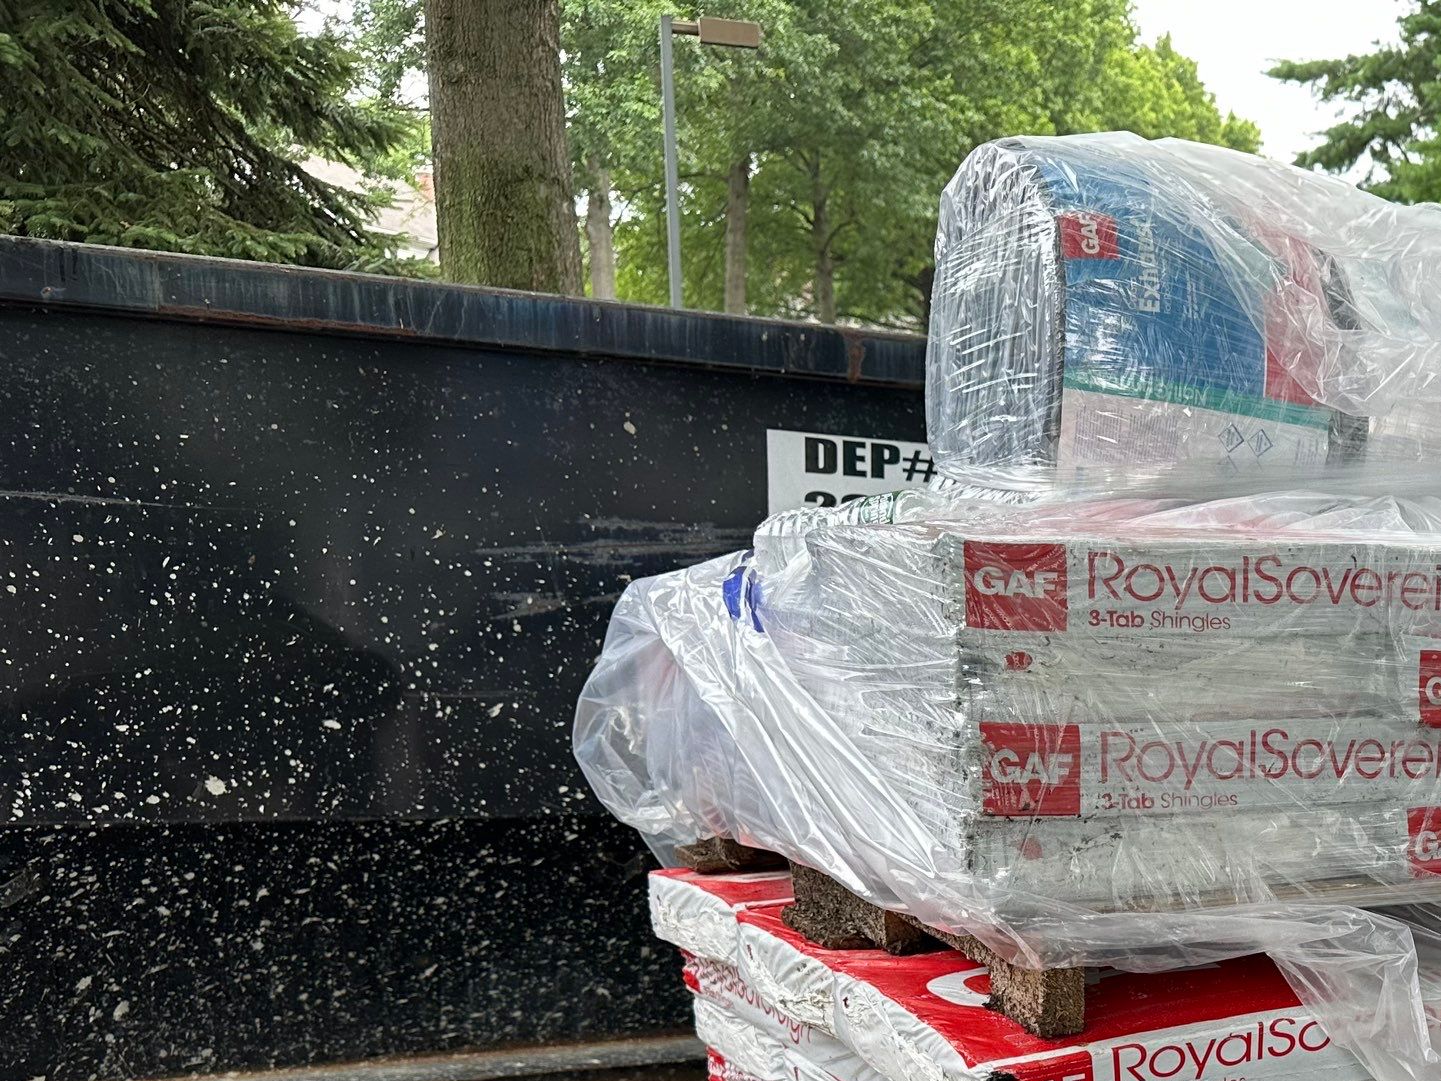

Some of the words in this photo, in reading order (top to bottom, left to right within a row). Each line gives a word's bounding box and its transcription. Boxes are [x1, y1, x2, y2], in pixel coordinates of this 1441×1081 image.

[805, 436, 938, 483] DEP#
[973, 569, 1058, 598] GAF
[1088, 608, 1144, 629] 3-Tab
[1150, 609, 1231, 632] Shingles
[991, 753, 1072, 787] GAF
[1160, 790, 1238, 809] Shingles
